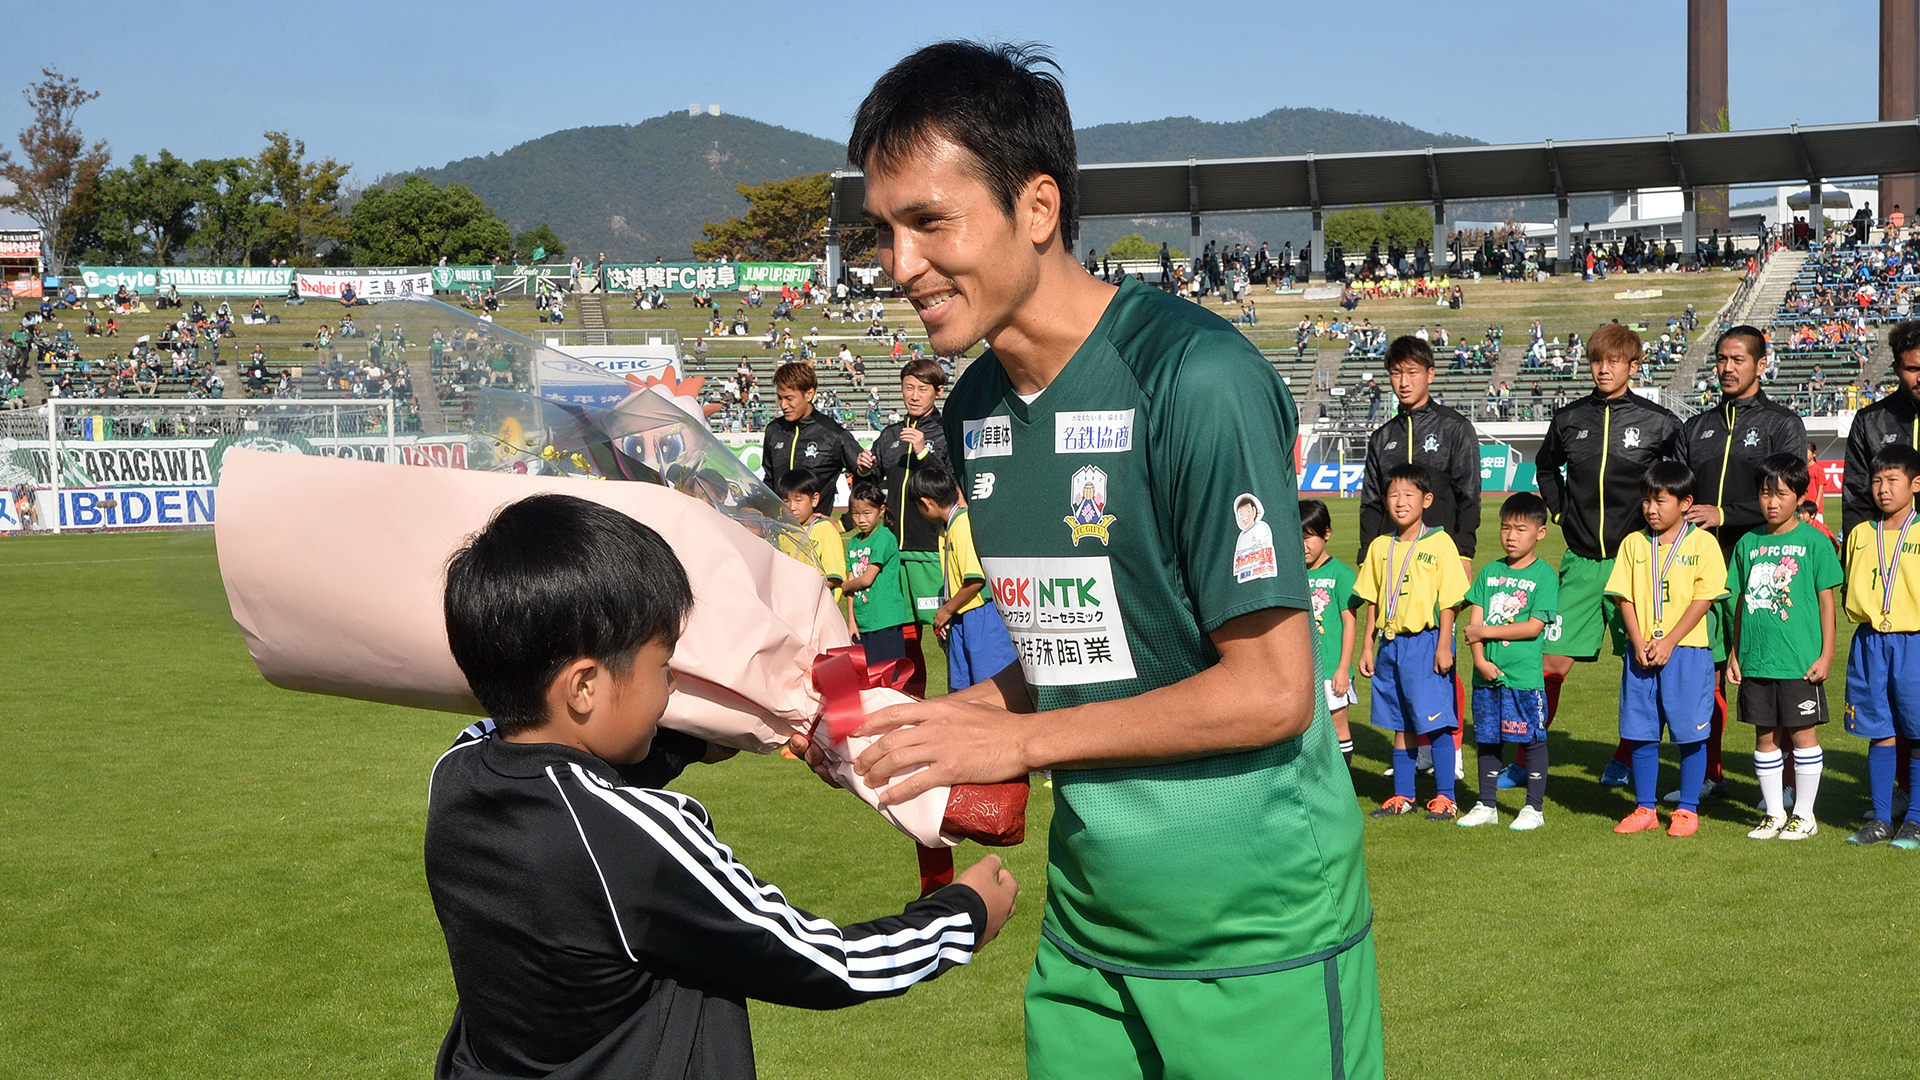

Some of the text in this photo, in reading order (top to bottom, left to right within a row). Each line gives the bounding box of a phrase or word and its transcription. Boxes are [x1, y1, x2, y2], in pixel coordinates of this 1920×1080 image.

[161, 269, 292, 285] STRATEGY & FANTASY
[455, 269, 492, 281] ROUTE 19
[513, 265, 551, 276] Route 19
[607, 265, 736, 290] 快進撃FC岐阜
[743, 267, 768, 281] JUMP
[83, 271, 156, 290] G-style
[300, 279, 363, 296] Shohei Oé!
[1063, 425, 1130, 450] 名鉄協商
[1481, 456, 1506, 468] 安田
[1310, 464, 1366, 490] ヒマ
[59, 489, 215, 525] IBIDEN
[1768, 545, 1781, 557] FC
[1781, 544, 1806, 557] GIFU
[1505, 576, 1518, 588] FC
[990, 577, 1031, 608] NGK
[1039, 576, 1101, 608] NTK
[1040, 611, 1103, 624] ニューセラミック
